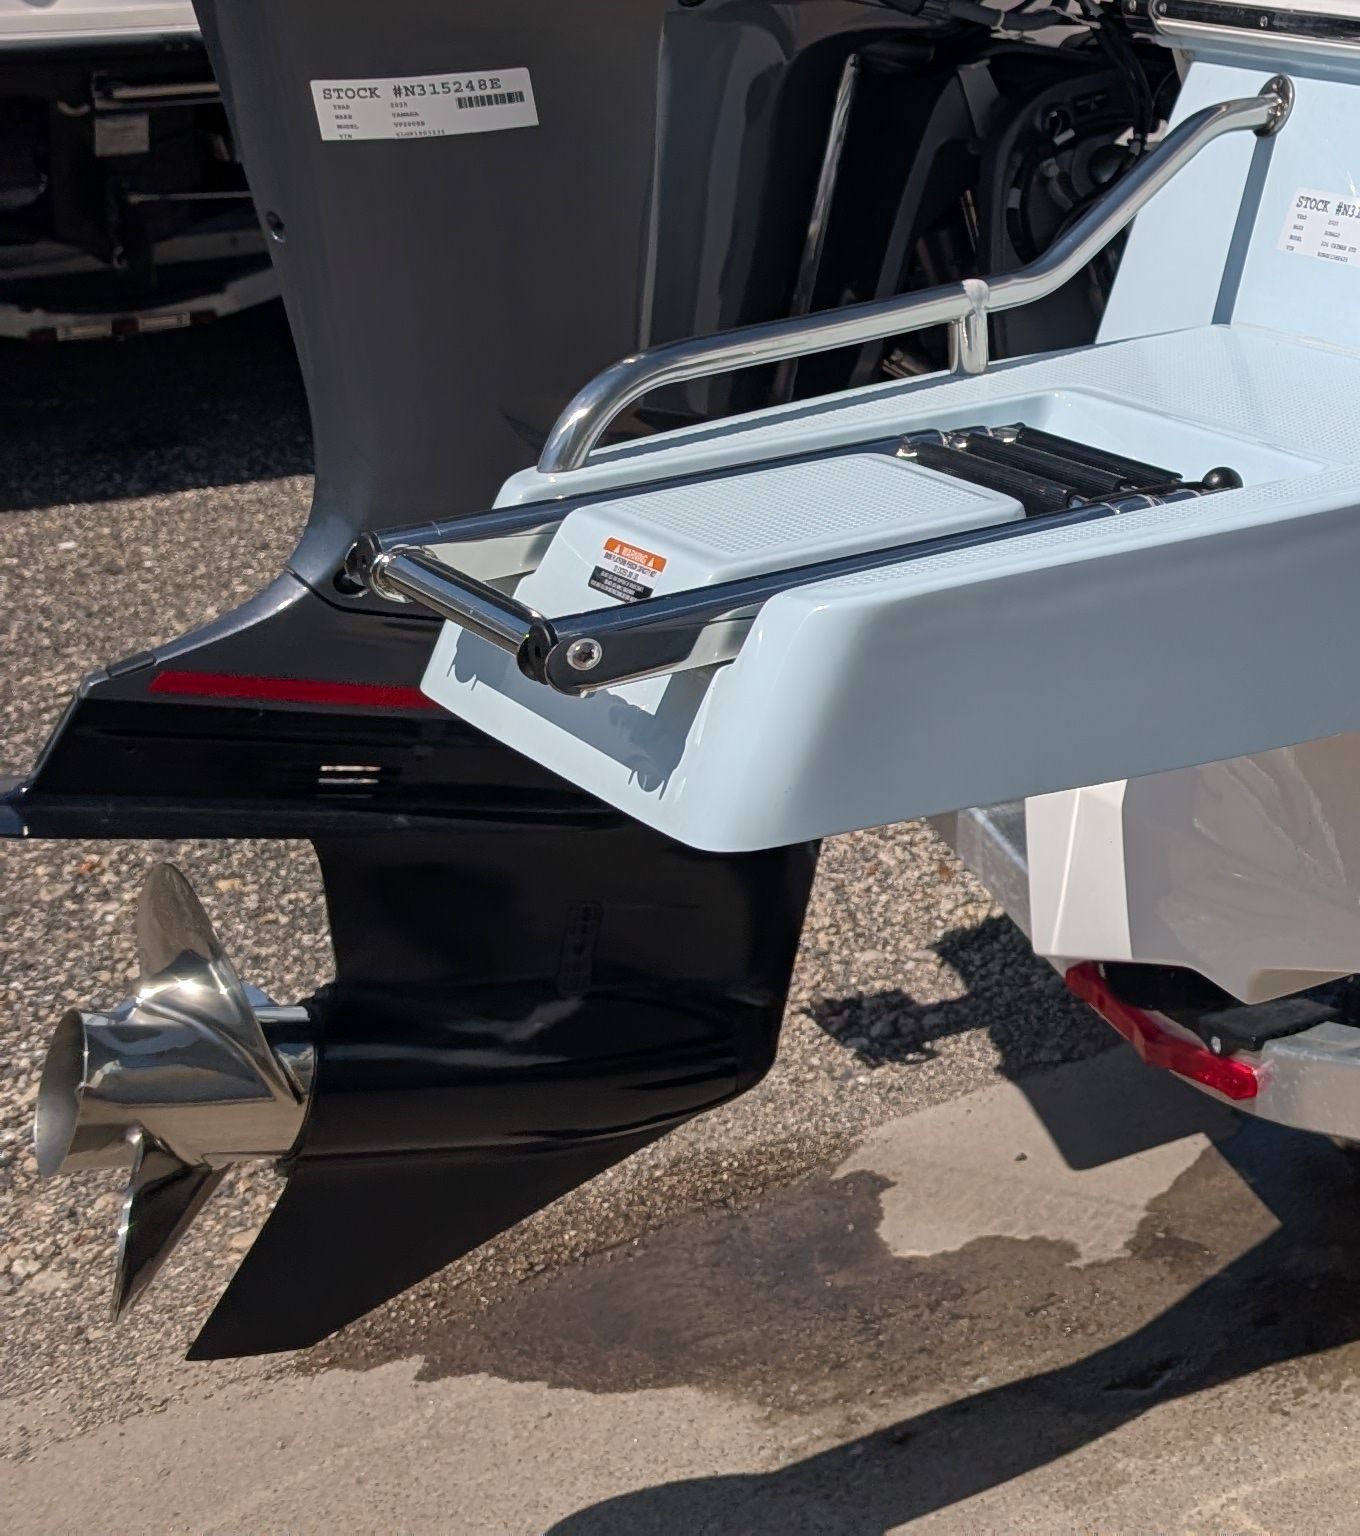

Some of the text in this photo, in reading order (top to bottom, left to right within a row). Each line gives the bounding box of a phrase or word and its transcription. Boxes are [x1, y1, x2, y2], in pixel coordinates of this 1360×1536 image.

[322, 78, 501, 101] STOCK #N315248E
[1296, 195, 1330, 213] STOCK
